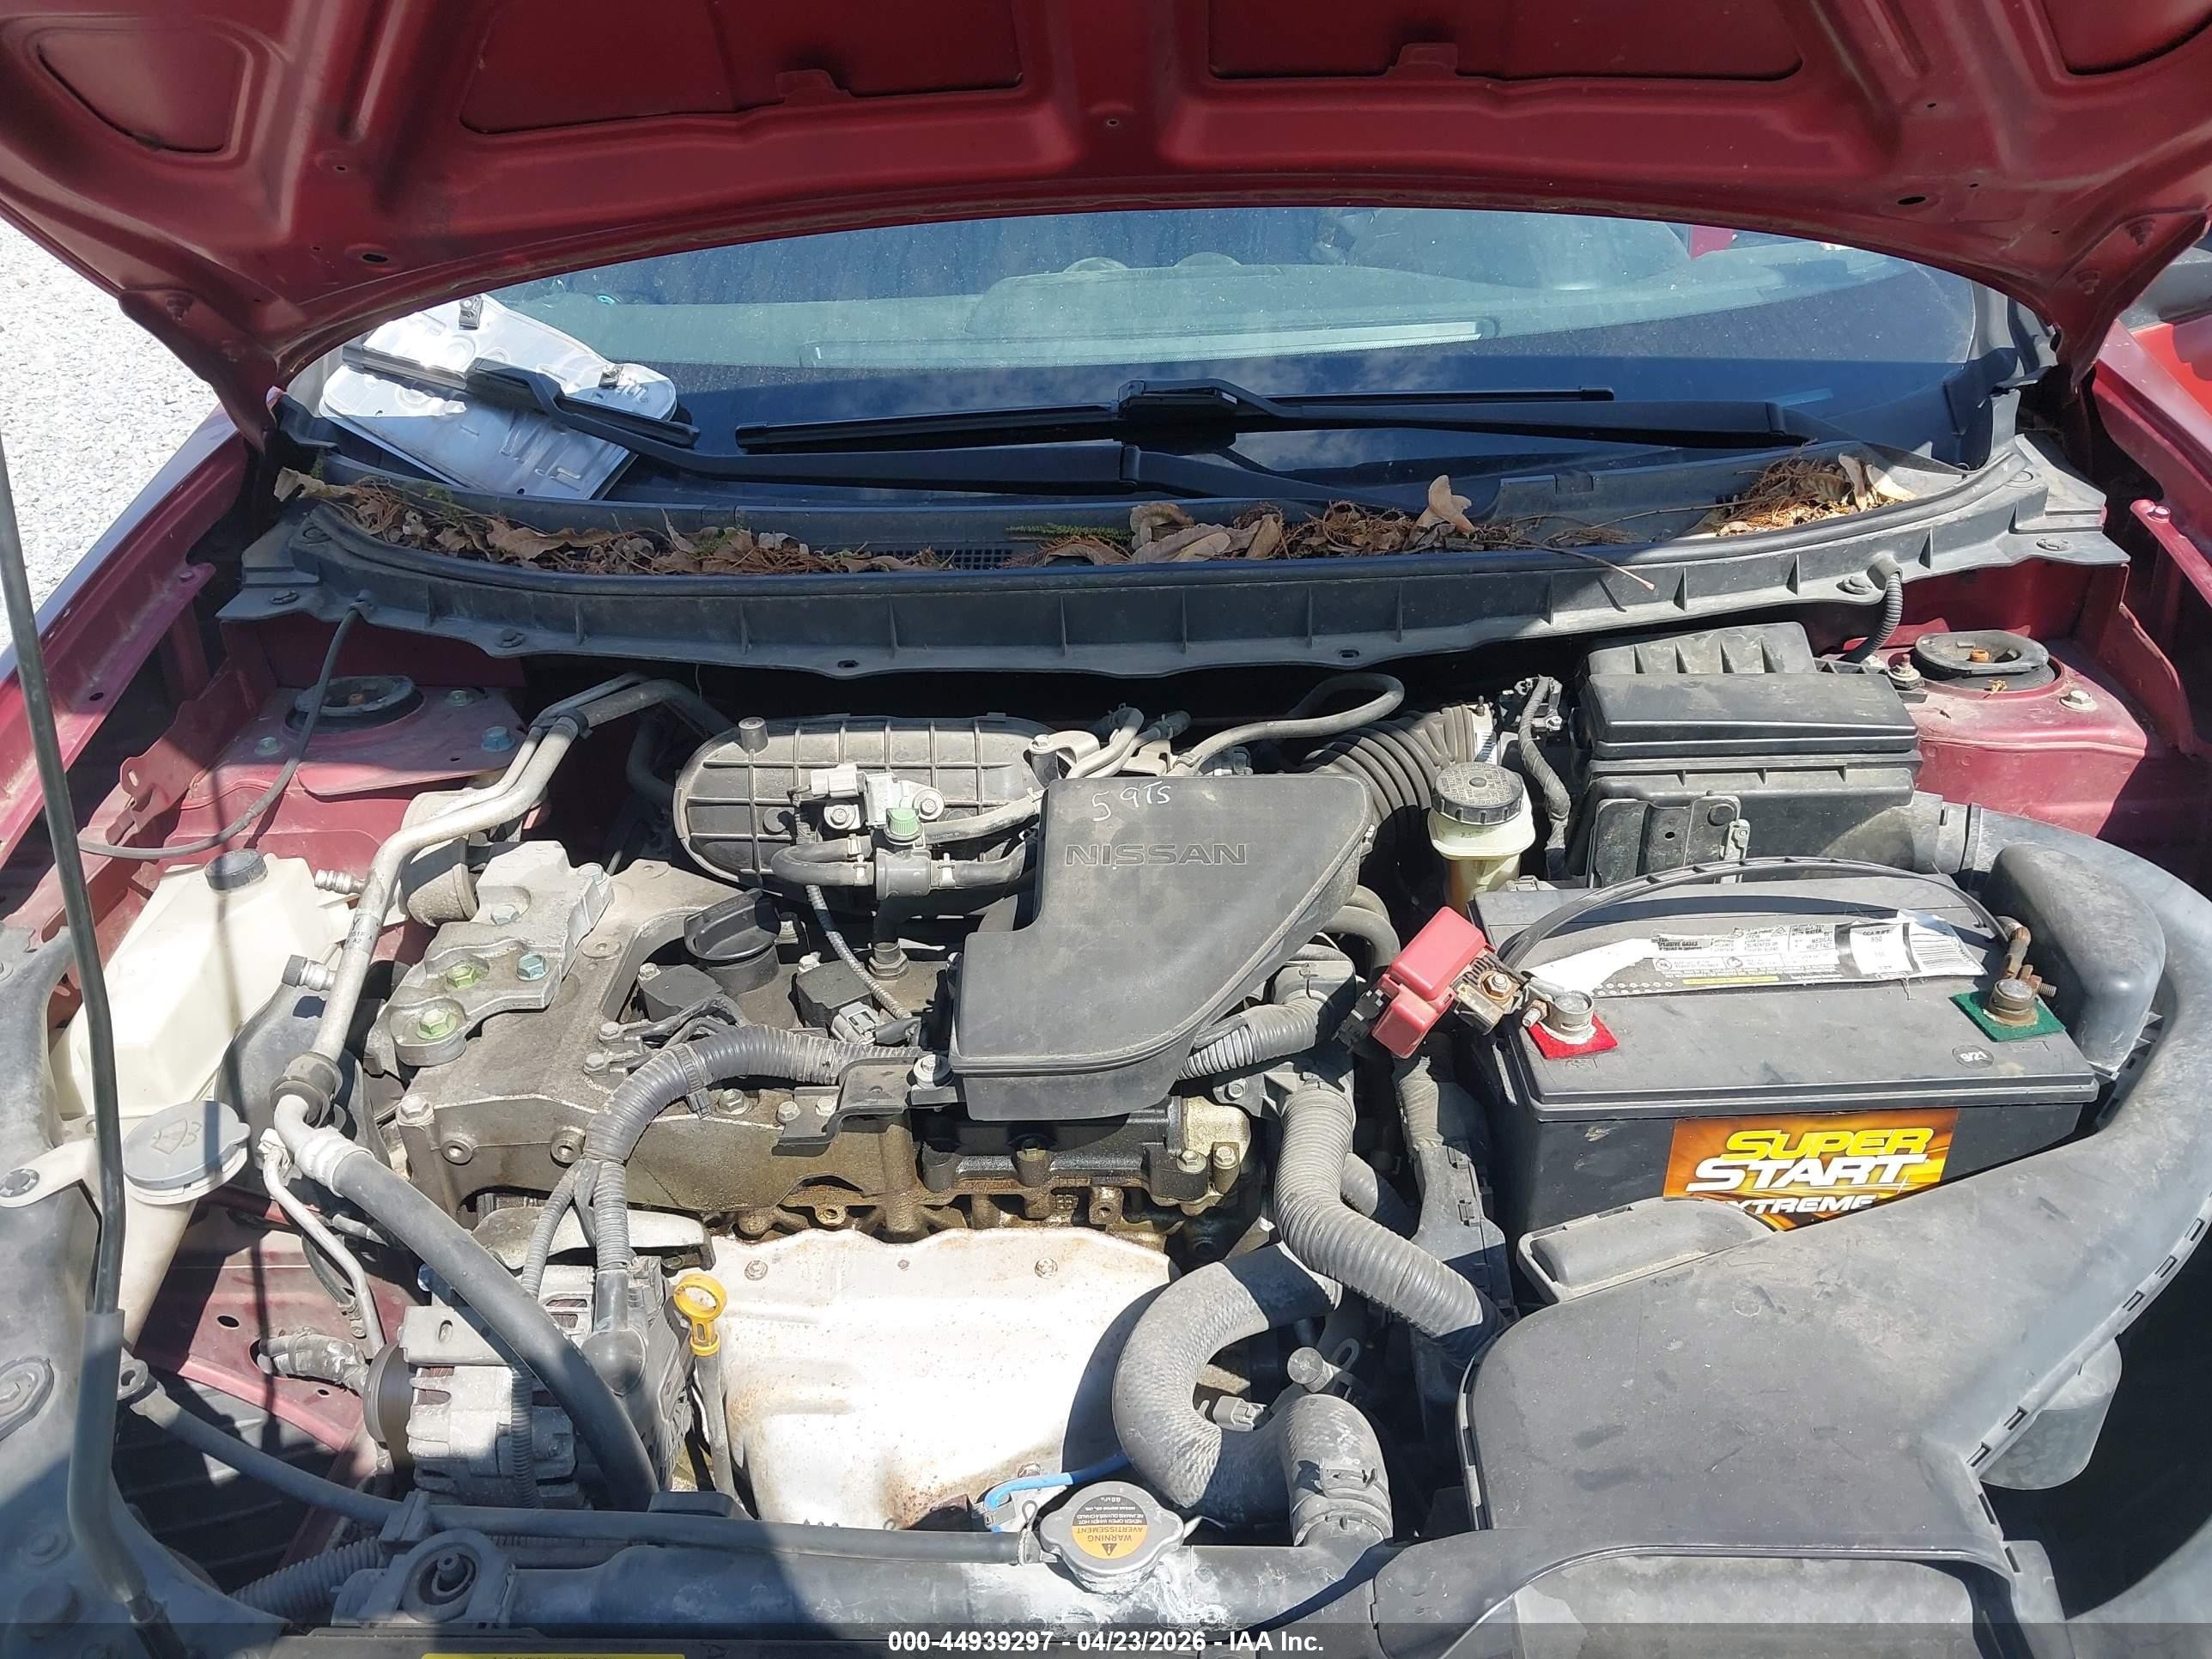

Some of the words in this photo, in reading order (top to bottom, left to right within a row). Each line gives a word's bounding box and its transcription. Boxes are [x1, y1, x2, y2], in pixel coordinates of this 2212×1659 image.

[1066, 843, 1247, 866] NISSAN
[1722, 1128, 1934, 1160] SUPER
[1686, 1154, 1927, 1191] START
